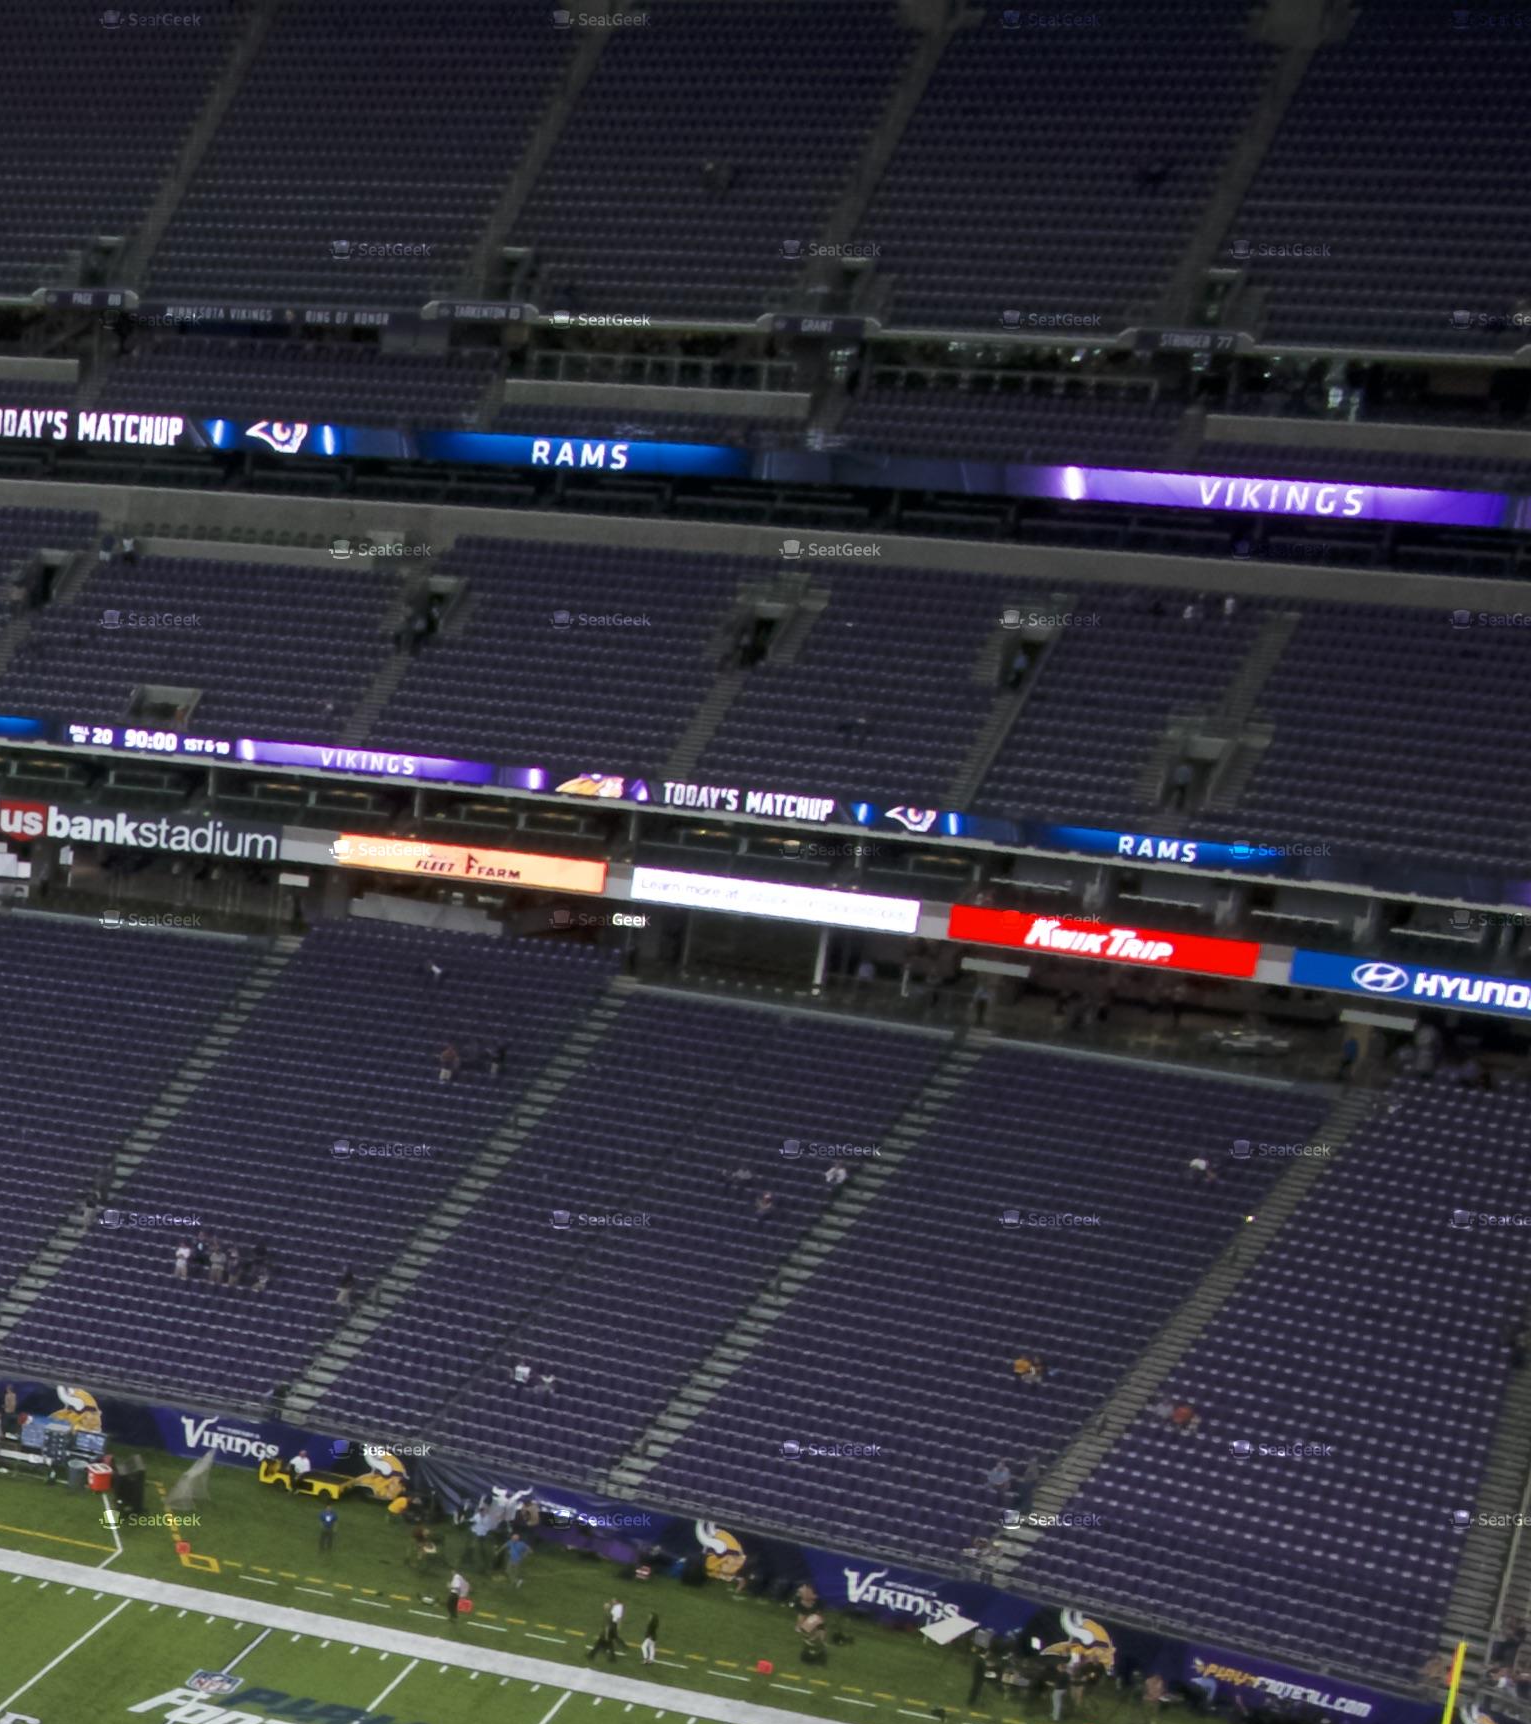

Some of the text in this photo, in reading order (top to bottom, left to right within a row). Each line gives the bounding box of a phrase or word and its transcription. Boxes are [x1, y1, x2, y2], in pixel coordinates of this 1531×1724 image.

[229, 307, 273, 322] VIKINGS
[800, 319, 834, 332] GRANT
[1216, 335, 1234, 349] 77
[77, 411, 184, 446] MATCHUP
[531, 440, 629, 470] RAMS
[1199, 480, 1365, 516] VIKINGS
[92, 727, 113, 745] 20
[124, 728, 178, 751] 90:00
[321, 749, 415, 775] VIKINGS
[664, 782, 835, 822] TODAY'S MATCHUP
[1118, 835, 1198, 863] RAMS
[414, 859, 521, 880] FLEET FARM
[641, 877, 681, 893] Learn
[685, 882, 721, 898] more
[1413, 971, 1531, 1008] HYUND
[180, 1414, 280, 1461] VIKINGS
[843, 1567, 960, 1620] VIKINGS
